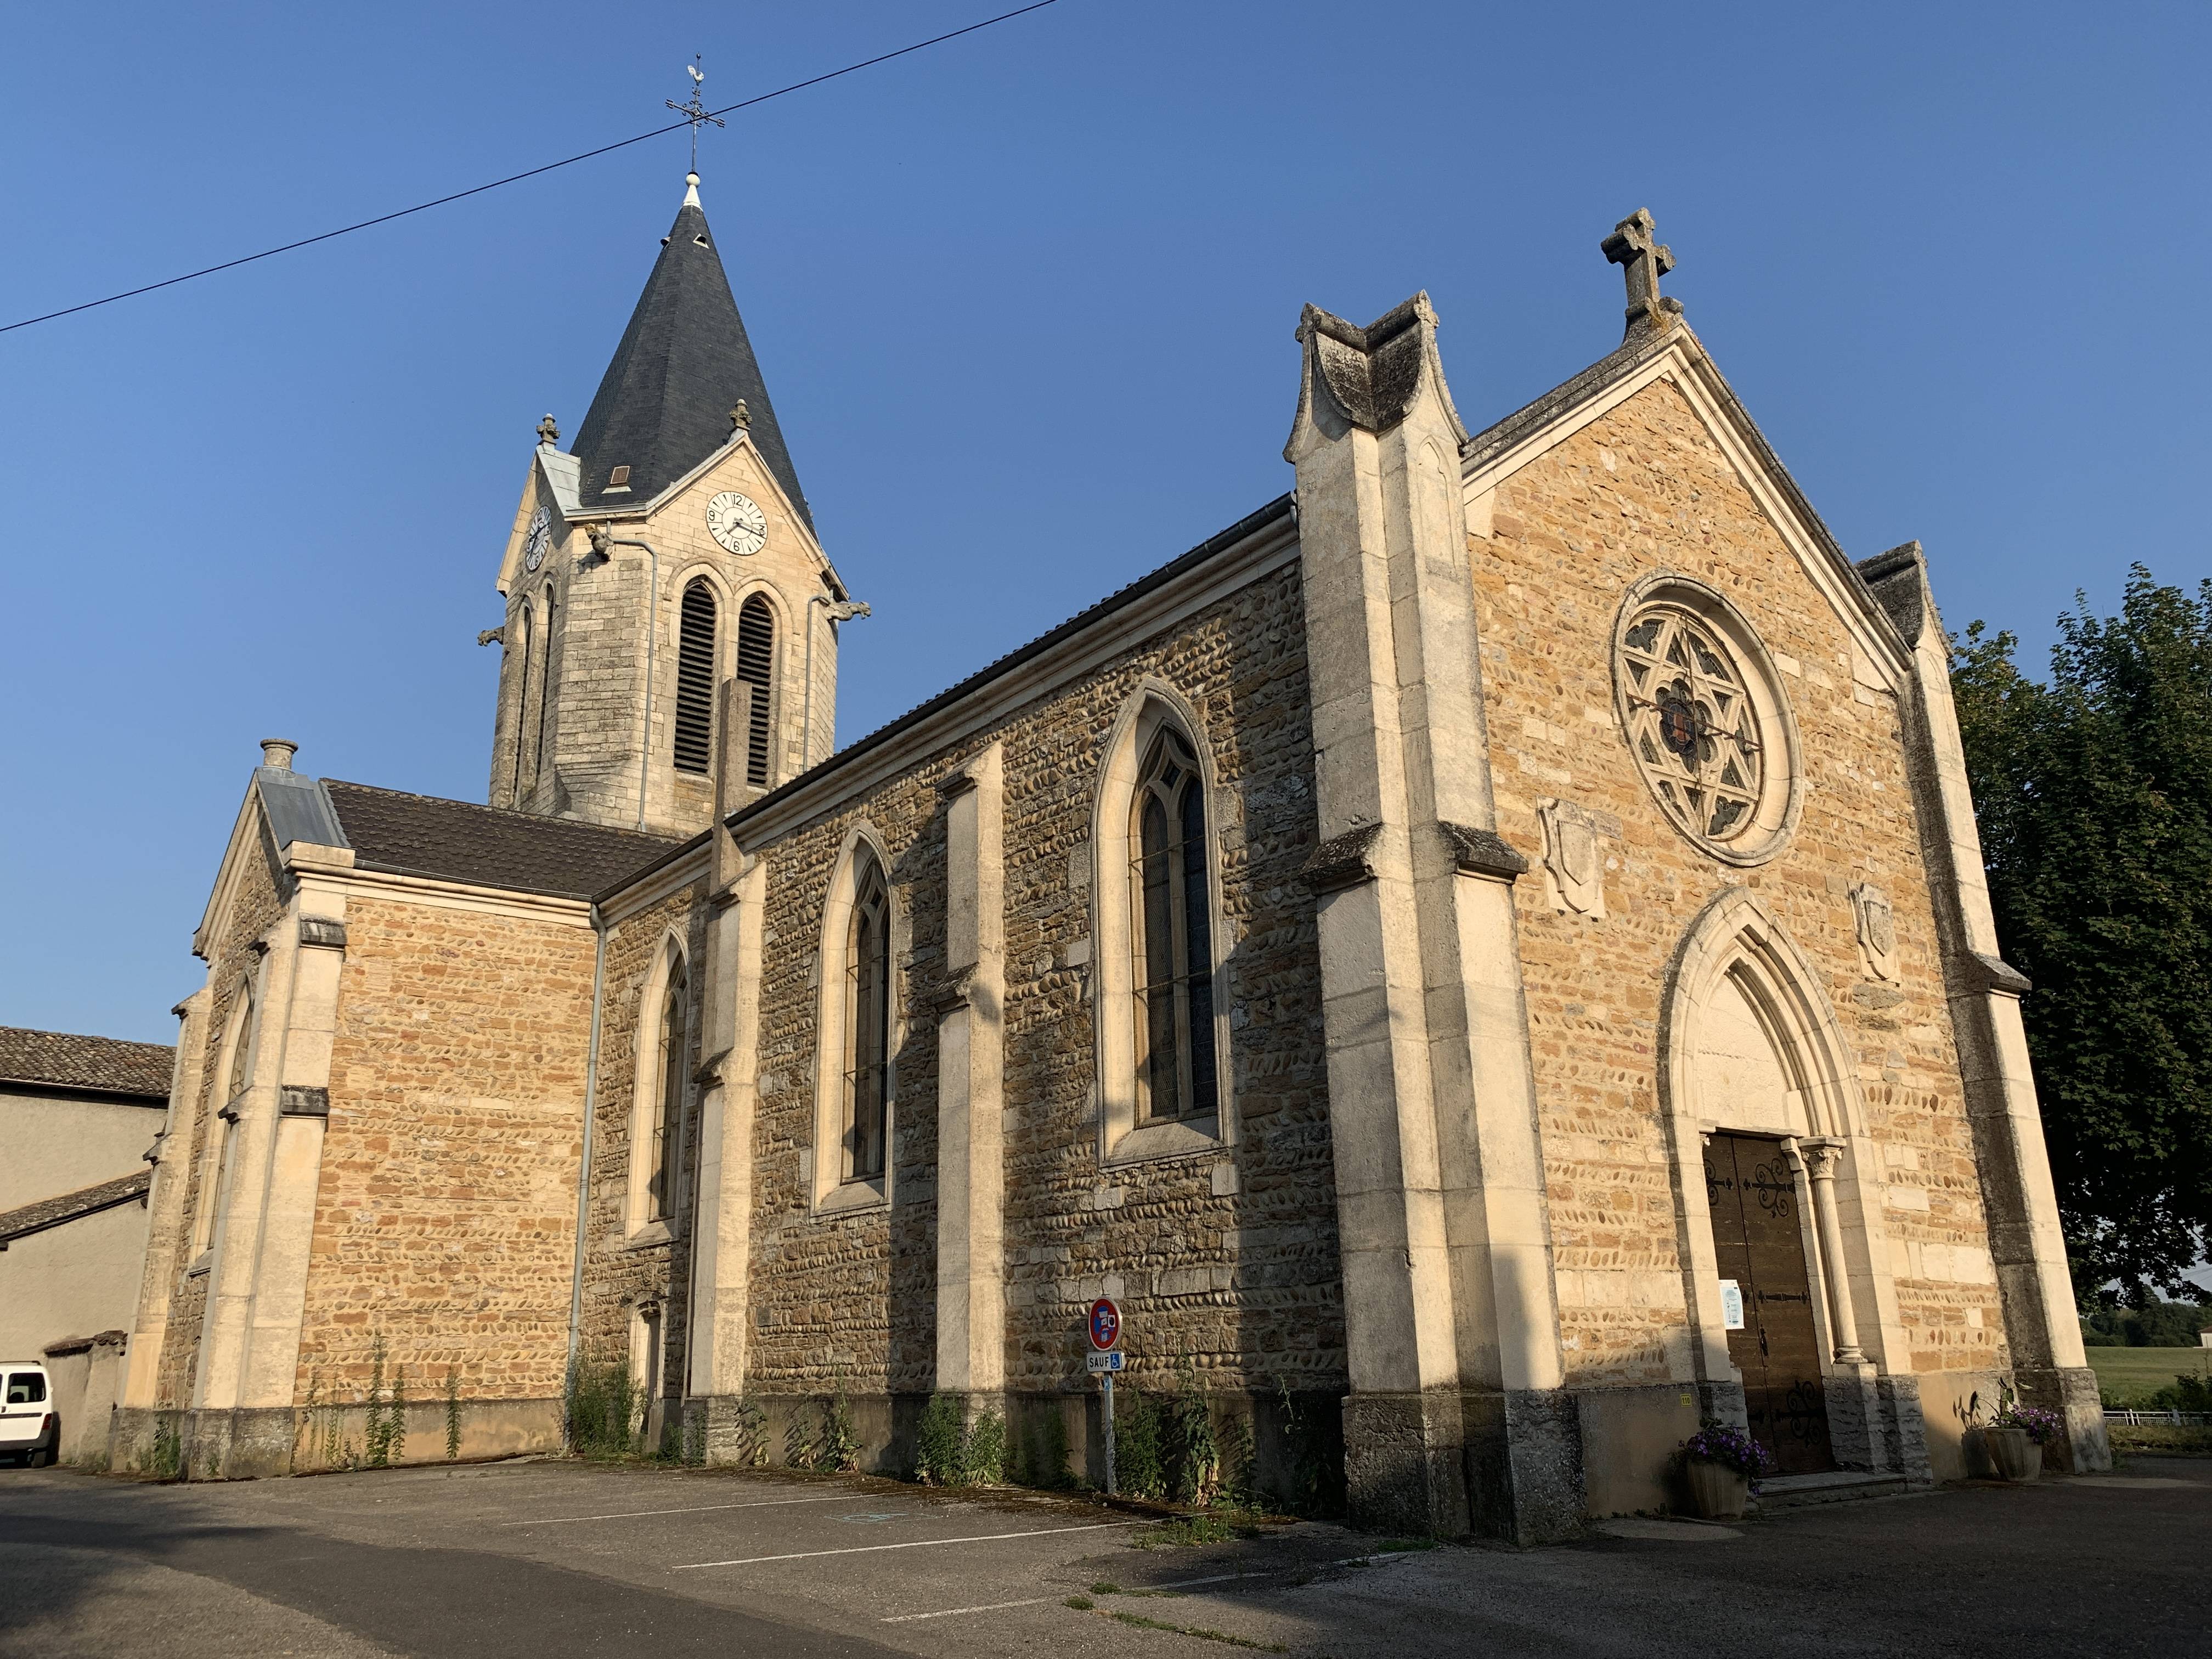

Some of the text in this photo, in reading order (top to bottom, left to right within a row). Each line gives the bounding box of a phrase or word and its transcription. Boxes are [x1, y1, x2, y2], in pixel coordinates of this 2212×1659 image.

[733, 494, 743, 506] 12
[708, 510, 715, 521] 9
[759, 524, 765, 536] 3
[733, 541, 740, 551] 6
[1090, 1356, 1109, 1368] SAUF
